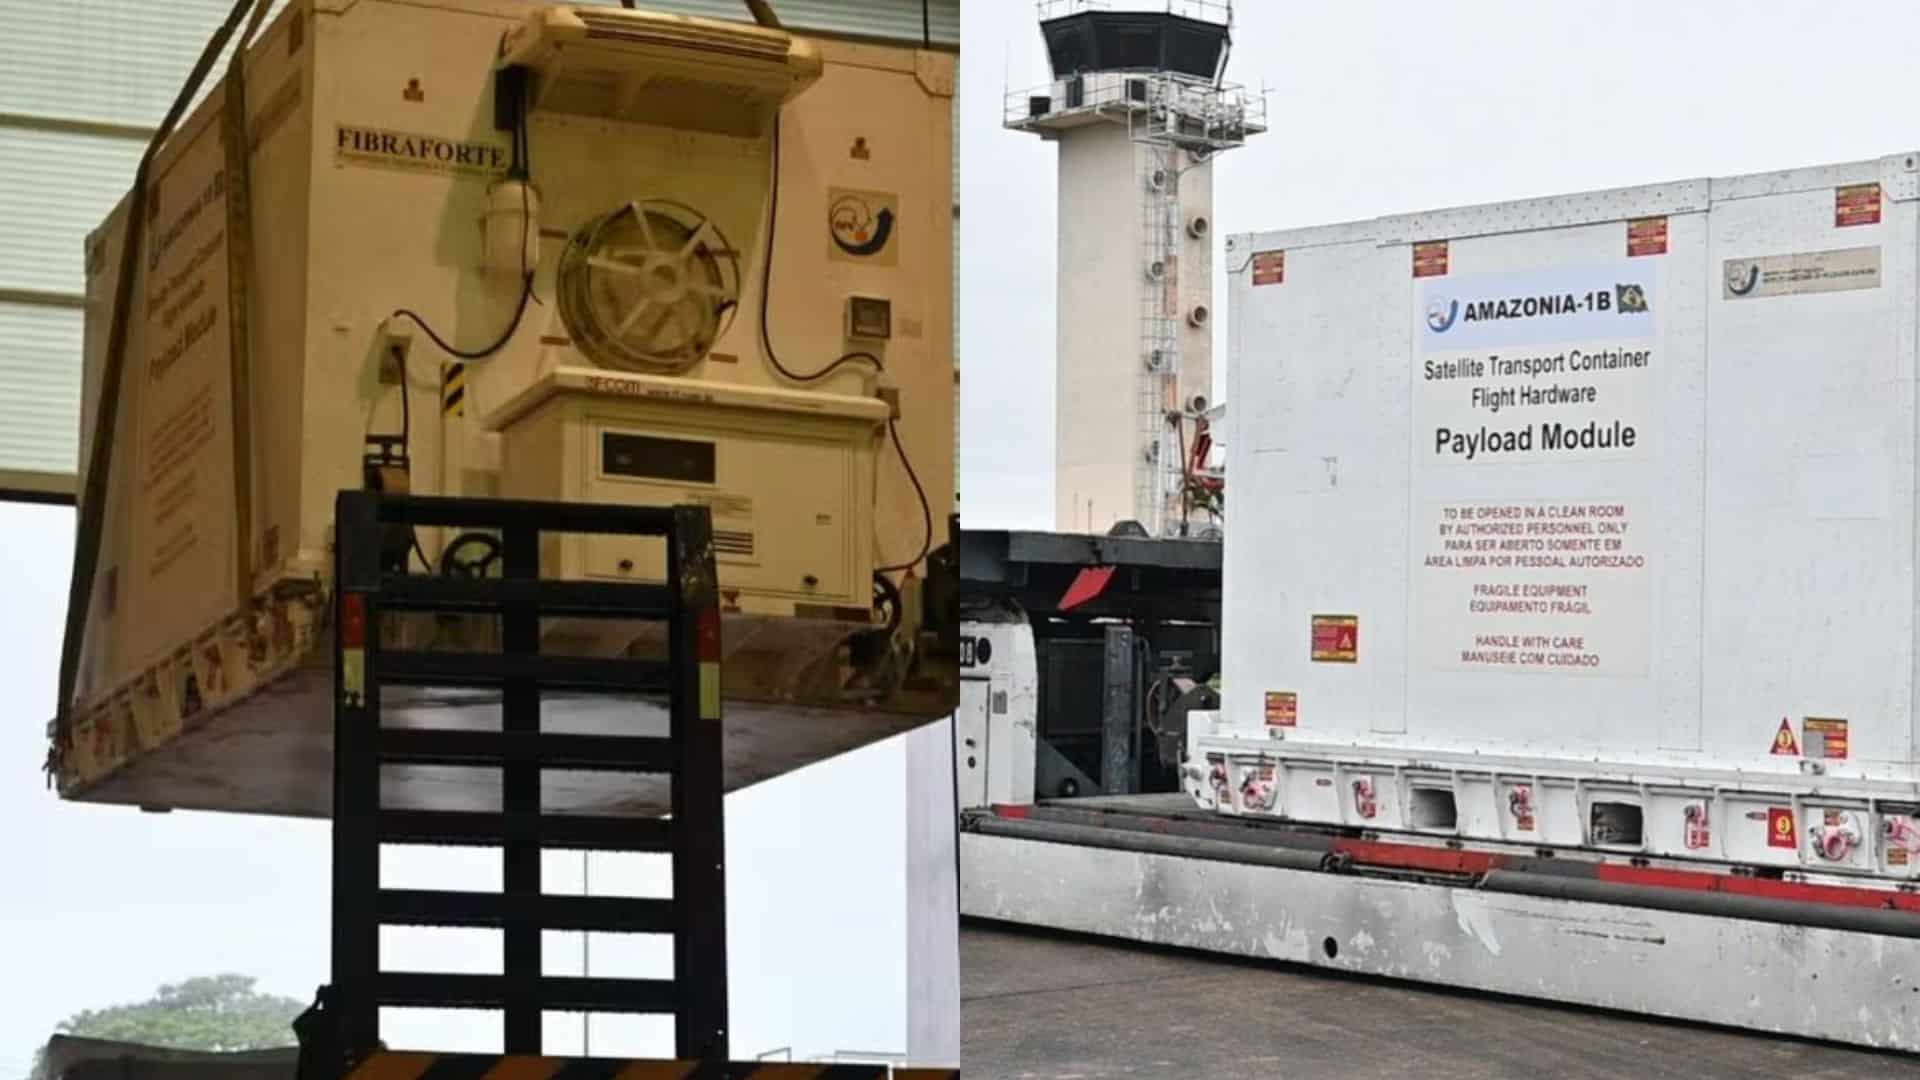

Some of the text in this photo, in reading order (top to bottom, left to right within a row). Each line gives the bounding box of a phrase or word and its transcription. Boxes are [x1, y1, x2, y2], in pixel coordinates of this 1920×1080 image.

[337, 126, 507, 170] FIBRAFORTE
[1463, 290, 1612, 323] AMAZONIA-1B
[1424, 346, 1651, 381] Satellite Transport Container
[1471, 383, 1598, 413] Flight Hardware
[1435, 419, 1637, 461] Payload Module
[1443, 504, 1624, 519] TO BE OPENED IN A CLEAN ROOM
[1439, 521, 1628, 536] BY AUTHORIZED PERSONNEL ONLY
[1444, 538, 1622, 551] PARA SER ABERTO SOMENTE EM
[1455, 555, 1488, 568] LIMPA
[1490, 555, 1512, 567] POR
[1515, 555, 1567, 567] PESSOAL
[1569, 554, 1645, 568] AUTORIZADO
[1473, 584, 1588, 598] FRAGILE EQUIPMENT
[1469, 600, 1548, 613] EQUIPAMENTO
[1475, 635, 1585, 649] HANDLE WITH CARE
[1461, 651, 1600, 667] MANUSEIE COM CUIDADO
